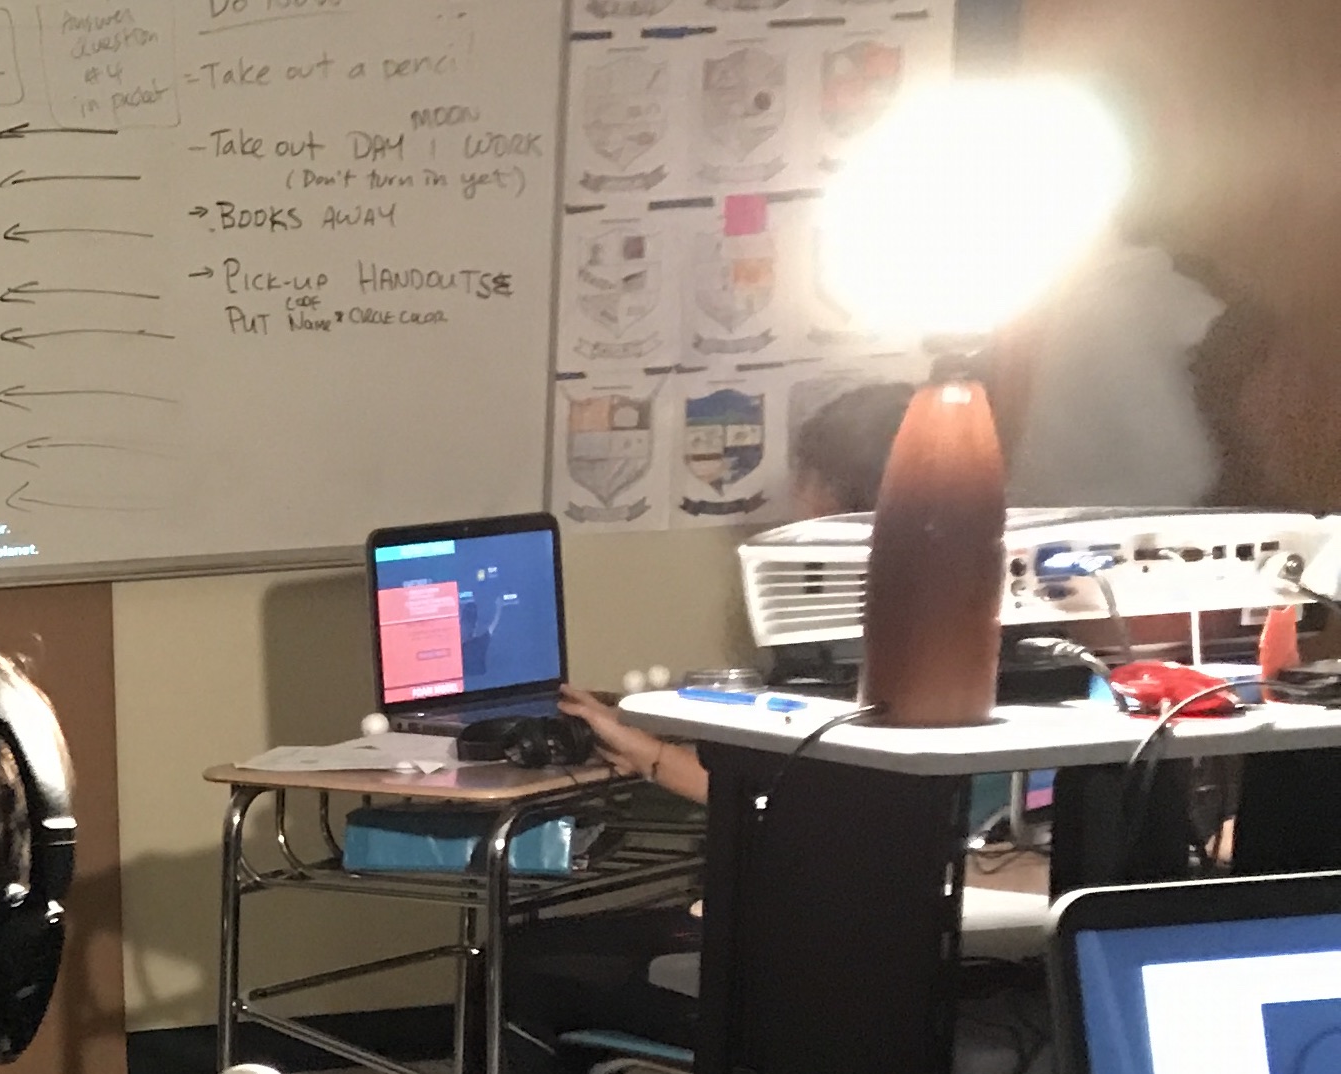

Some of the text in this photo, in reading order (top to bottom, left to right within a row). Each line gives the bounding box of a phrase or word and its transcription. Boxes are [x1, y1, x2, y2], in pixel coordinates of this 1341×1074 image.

[285, 51, 334, 80] out
[348, 61, 367, 80] a
[275, 131, 325, 158] out
[347, 132, 404, 162] DAY
[463, 131, 544, 159] WORK
[368, 168, 414, 189] turn
[424, 169, 448, 187] in
[216, 201, 397, 232] BOOKS AWAY
